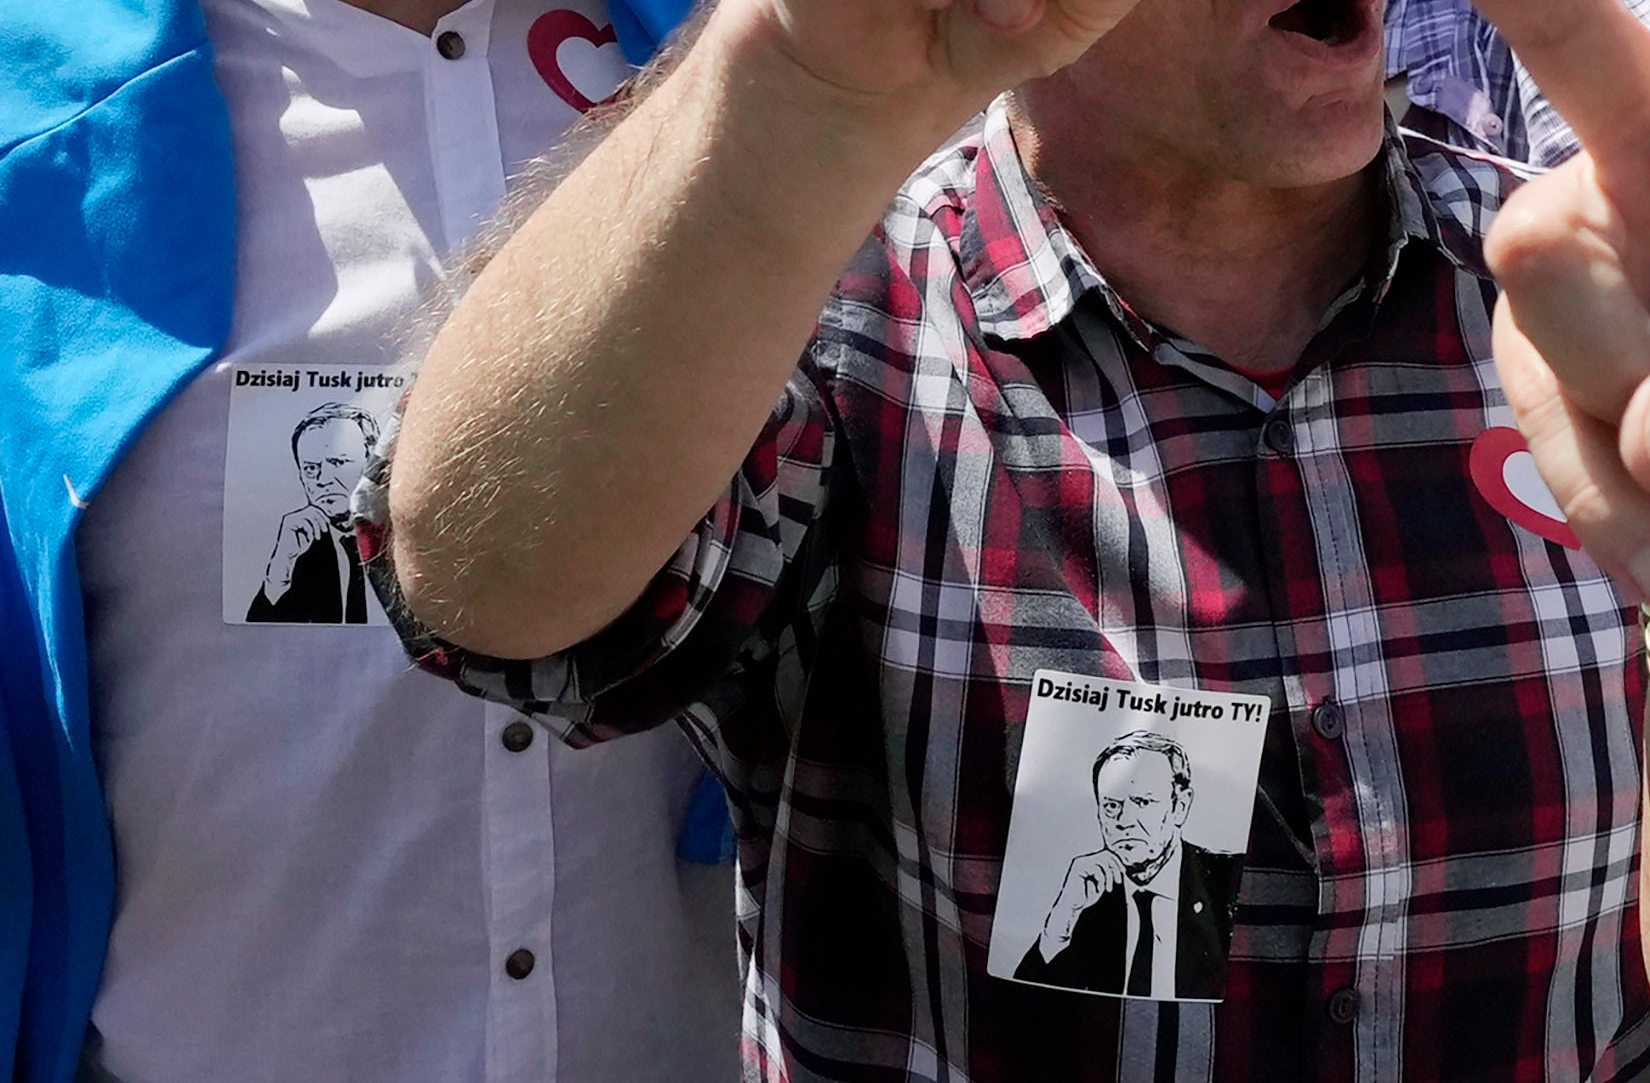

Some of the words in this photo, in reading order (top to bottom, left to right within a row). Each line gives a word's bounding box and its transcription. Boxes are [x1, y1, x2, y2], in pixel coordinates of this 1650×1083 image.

[235, 370, 300, 392] Dzisiaj
[306, 370, 352, 388] Tusk
[354, 371, 404, 393] jutro
[1036, 678, 1109, 712] Dzisiaj
[1116, 688, 1168, 715] Tusk
[1169, 696, 1224, 721] jutro
[1230, 702, 1263, 723] TY!
